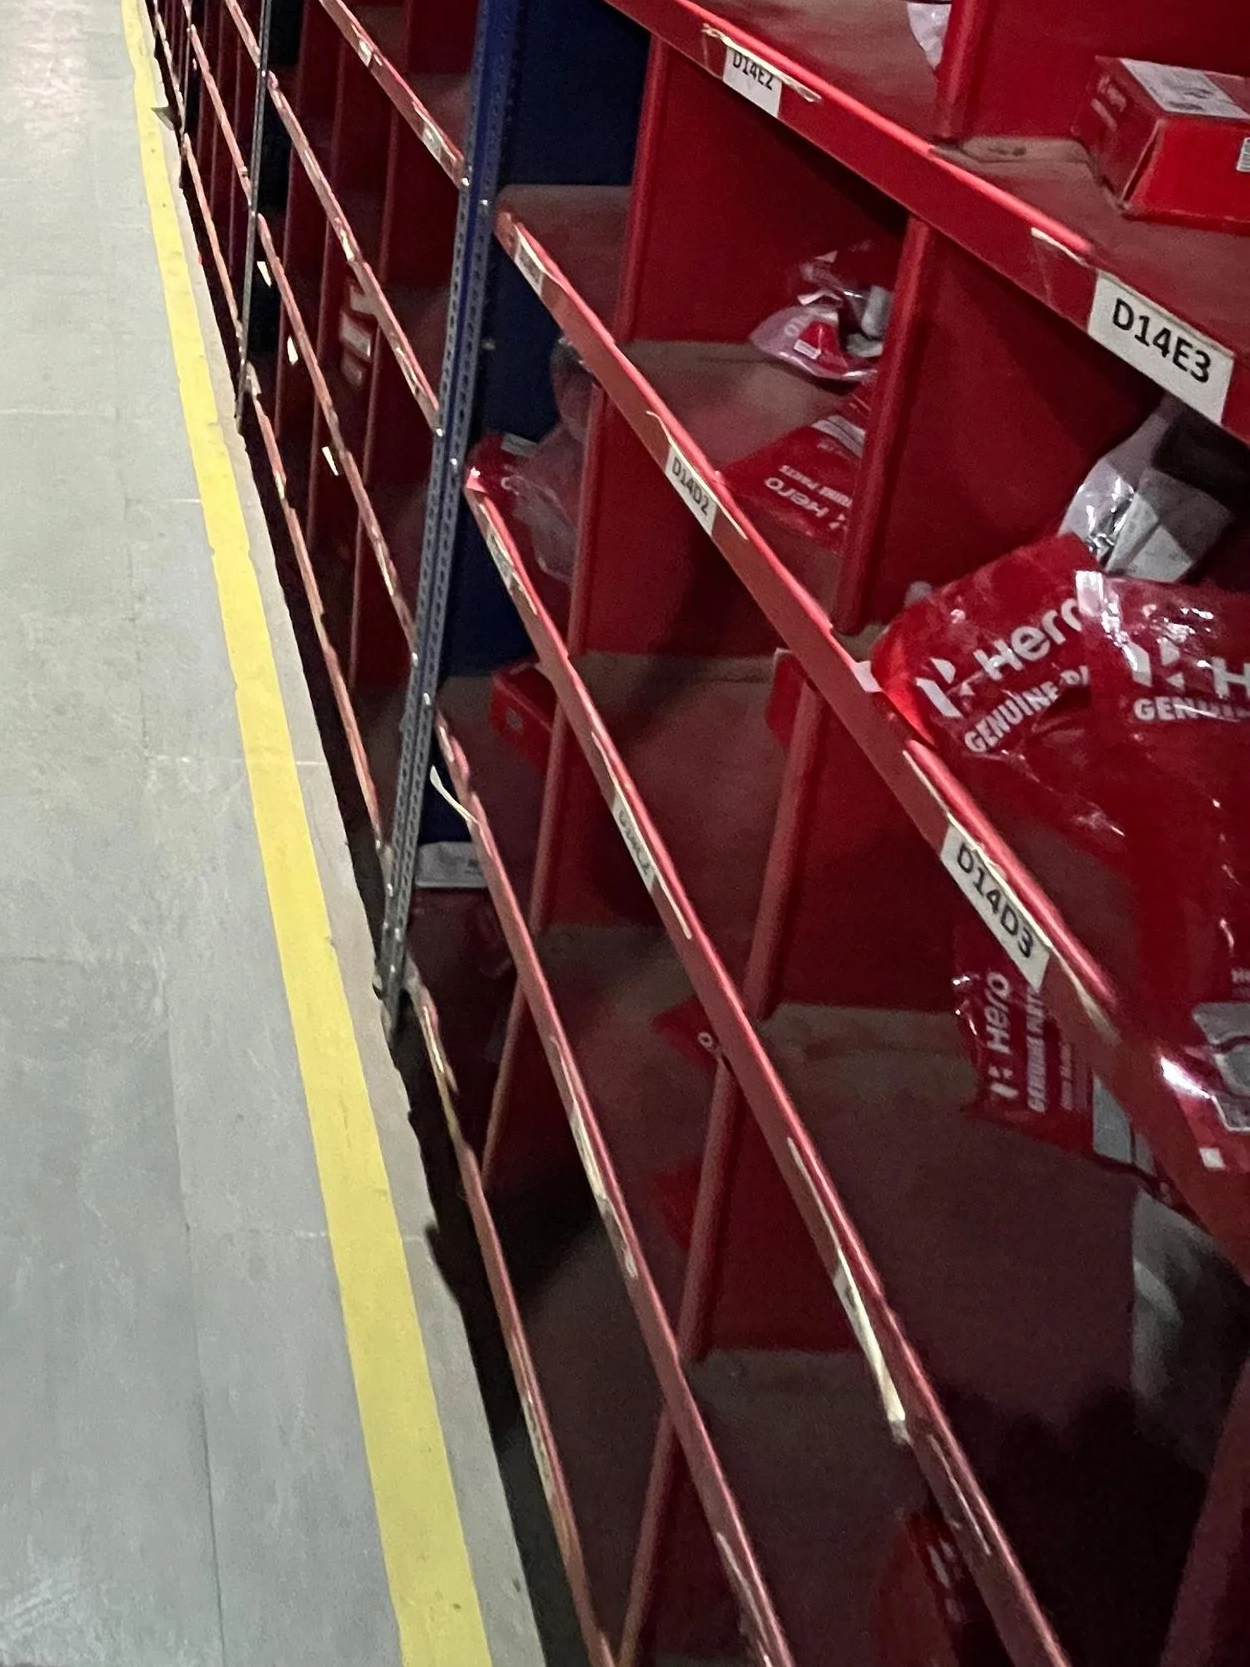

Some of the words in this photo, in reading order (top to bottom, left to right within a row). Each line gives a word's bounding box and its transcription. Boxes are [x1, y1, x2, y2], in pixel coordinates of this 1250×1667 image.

[732, 51, 773, 91] D14E2
[1111, 297, 1213, 385] D14E3
[671, 456, 711, 518] D14D2
[765, 477, 830, 518] Hero
[964, 680, 1061, 754] GENUINE
[957, 842, 1036, 960] D14D3
[988, 971, 1012, 1057] Hero
